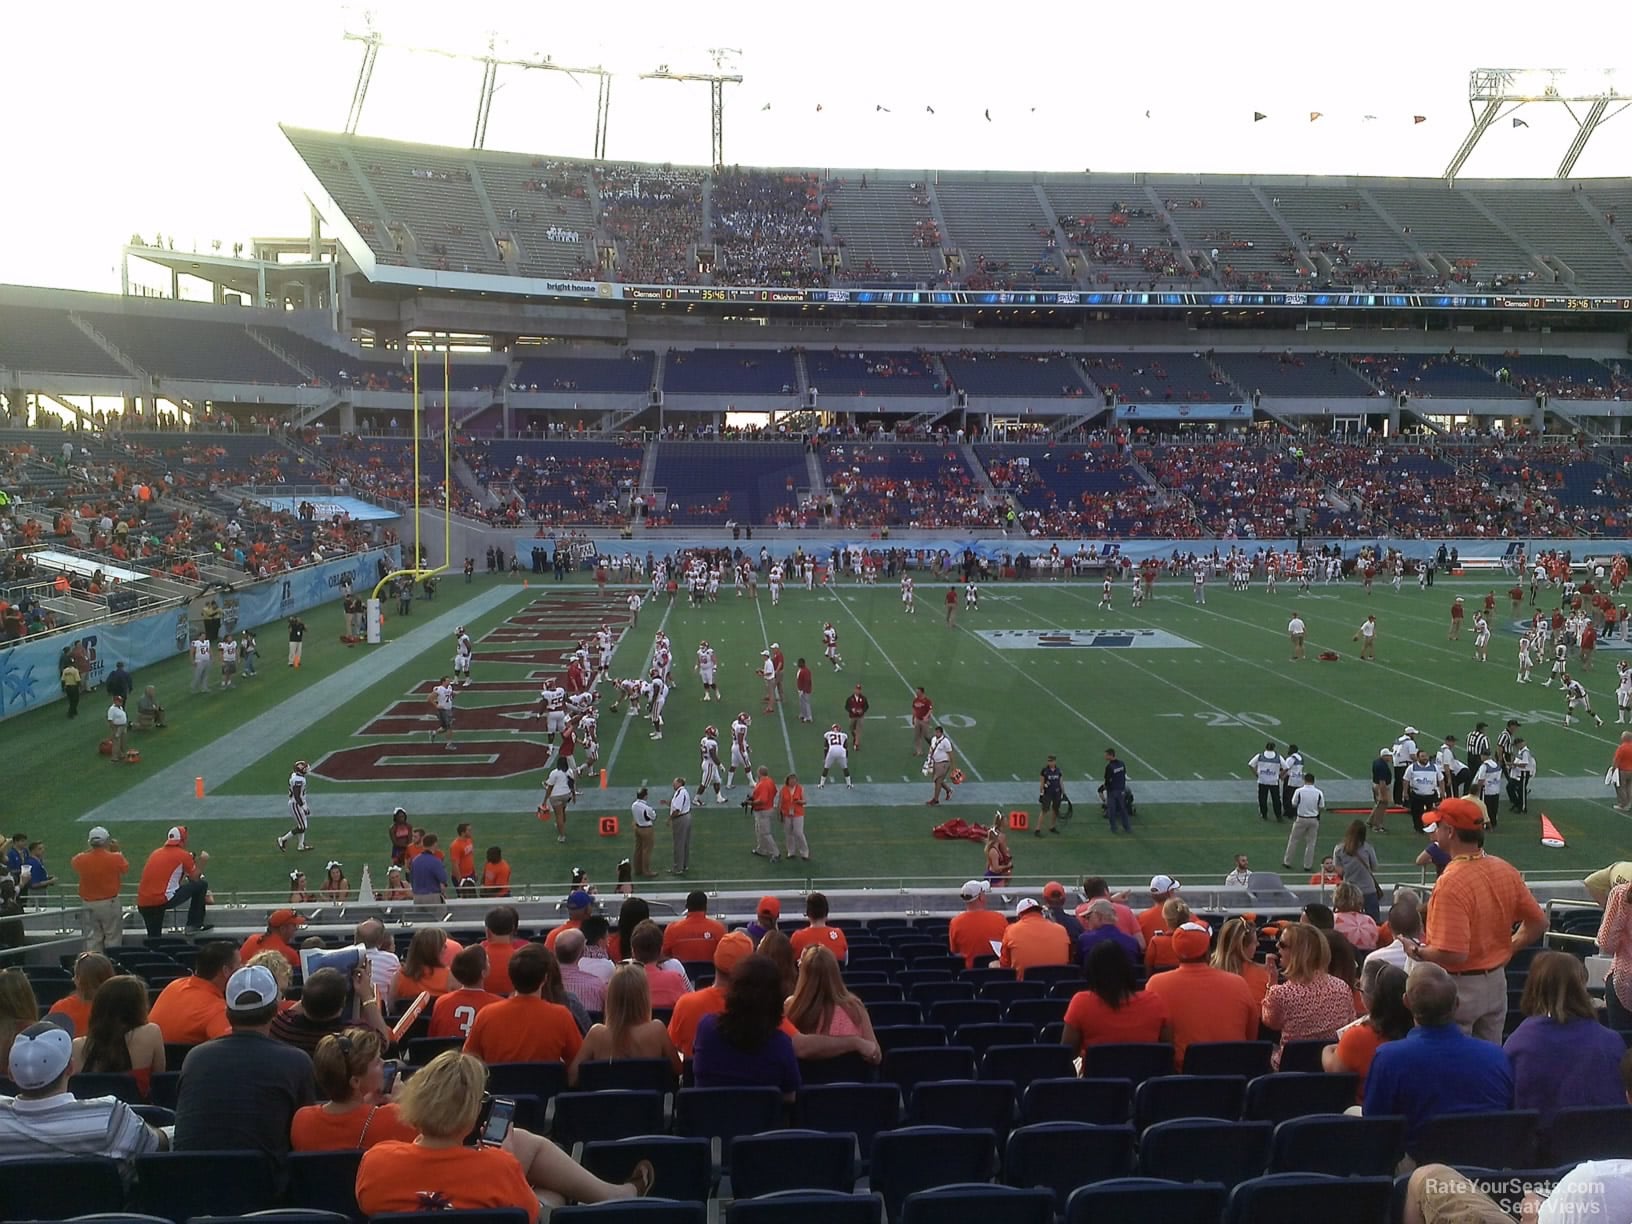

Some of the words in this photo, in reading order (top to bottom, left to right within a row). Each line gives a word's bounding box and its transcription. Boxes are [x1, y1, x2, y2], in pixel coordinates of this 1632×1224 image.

[547, 282, 571, 292] bright
[572, 283, 595, 292] house
[633, 290, 661, 298] Clemson
[665, 289, 672, 298] 0
[702, 290, 725, 300] 35:46
[761, 291, 768, 300] 0
[772, 293, 804, 301] Oklahoma
[1533, 299, 1540, 308] 0
[1567, 299, 1589, 309] 35:46
[1623, 299, 1630, 309] 0
[1193, 711, 1282, 727] 20
[829, 733, 842, 746] 21
[1012, 813, 1026, 827] 10
[601, 818, 615, 833] G
[454, 1005, 476, 1037] 3
